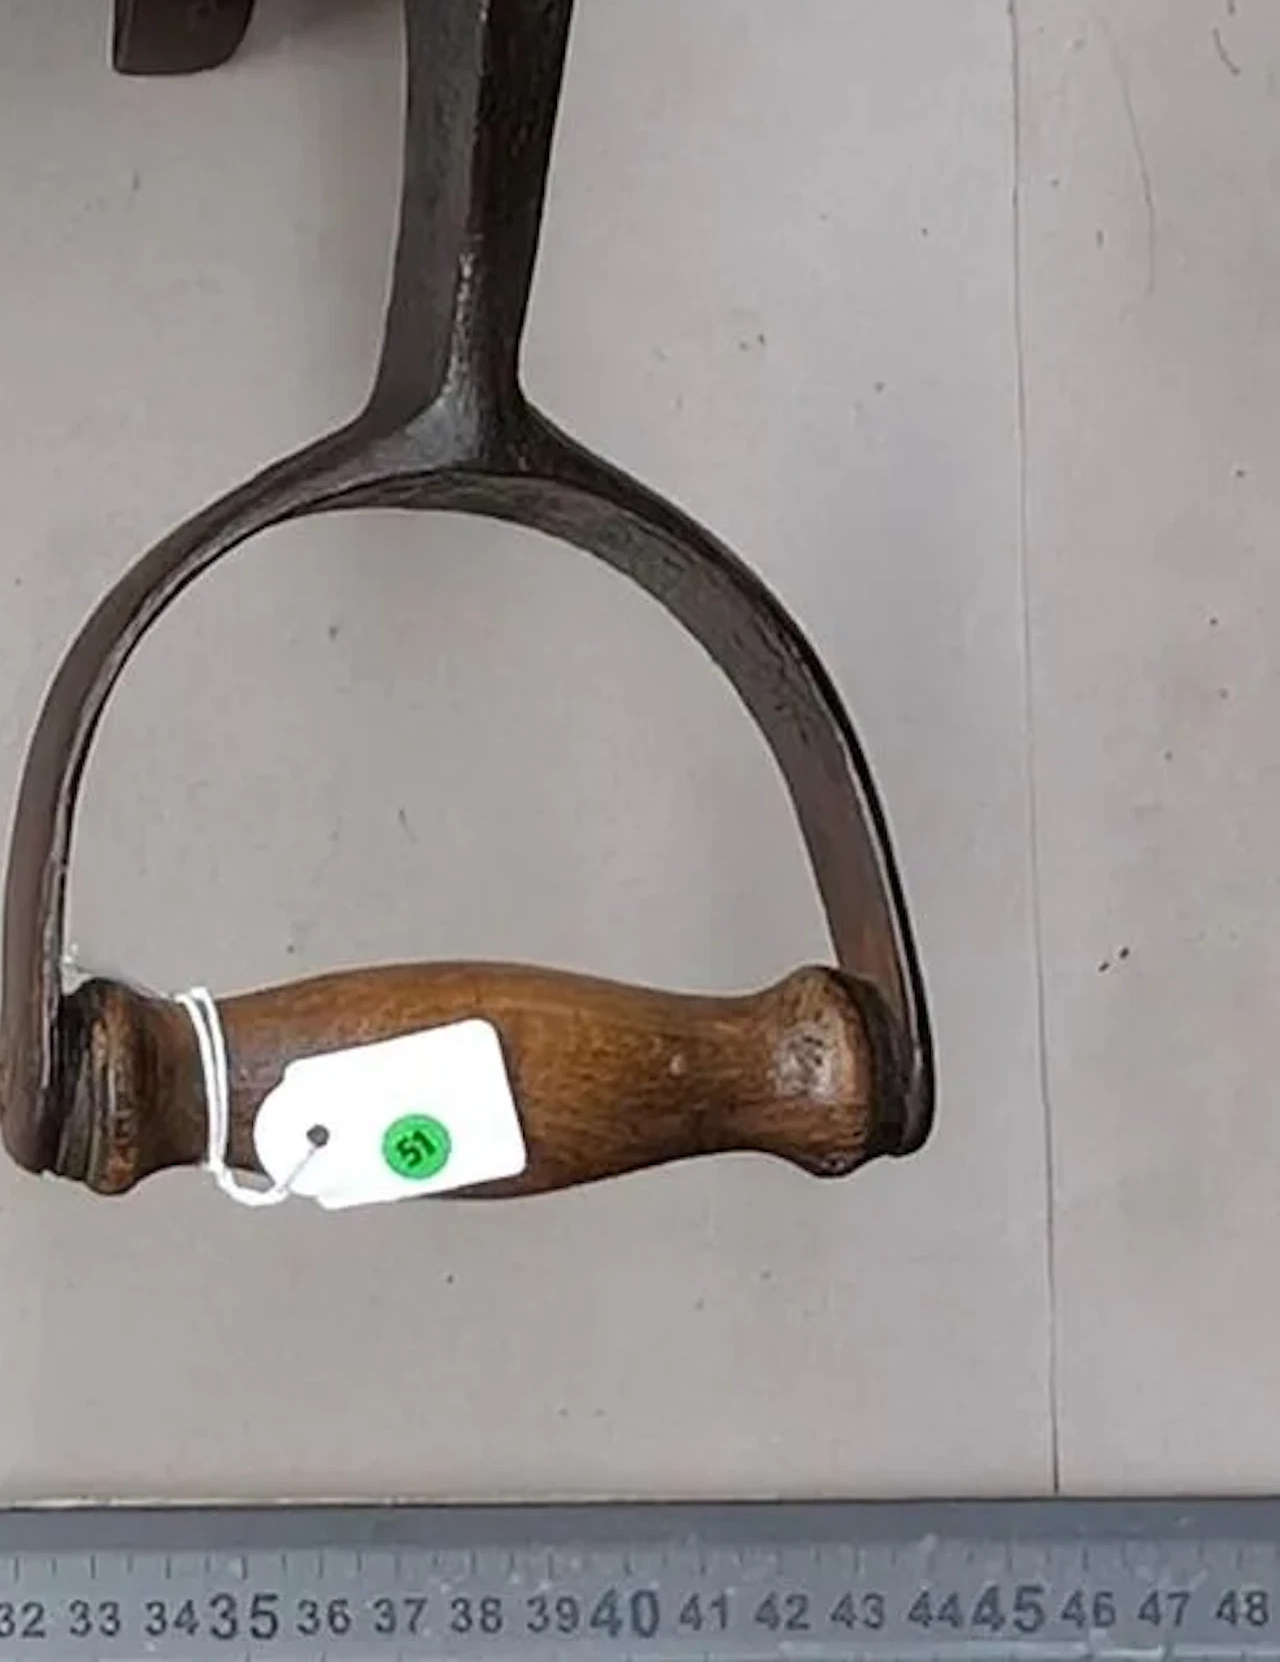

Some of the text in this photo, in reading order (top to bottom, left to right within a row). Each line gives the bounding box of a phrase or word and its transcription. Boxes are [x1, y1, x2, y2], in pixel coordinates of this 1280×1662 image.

[69, 1599, 122, 1638] 33
[144, 1599, 200, 1638] 34
[208, 1592, 280, 1642] 35
[296, 1598, 352, 1637] 36
[373, 1597, 428, 1636] 37
[450, 1596, 503, 1635] 38
[526, 1595, 580, 1634] 39
[589, 1588, 661, 1640] 40
[679, 1593, 728, 1632] 41
[754, 1592, 811, 1631] 42
[830, 1592, 885, 1631] 43
[907, 1590, 964, 1629] 44
[972, 1584, 1046, 1634] 45
[1060, 1590, 1116, 1630] 46
[1137, 1590, 1191, 1627] 47
[1215, 1590, 1270, 1628] 48
